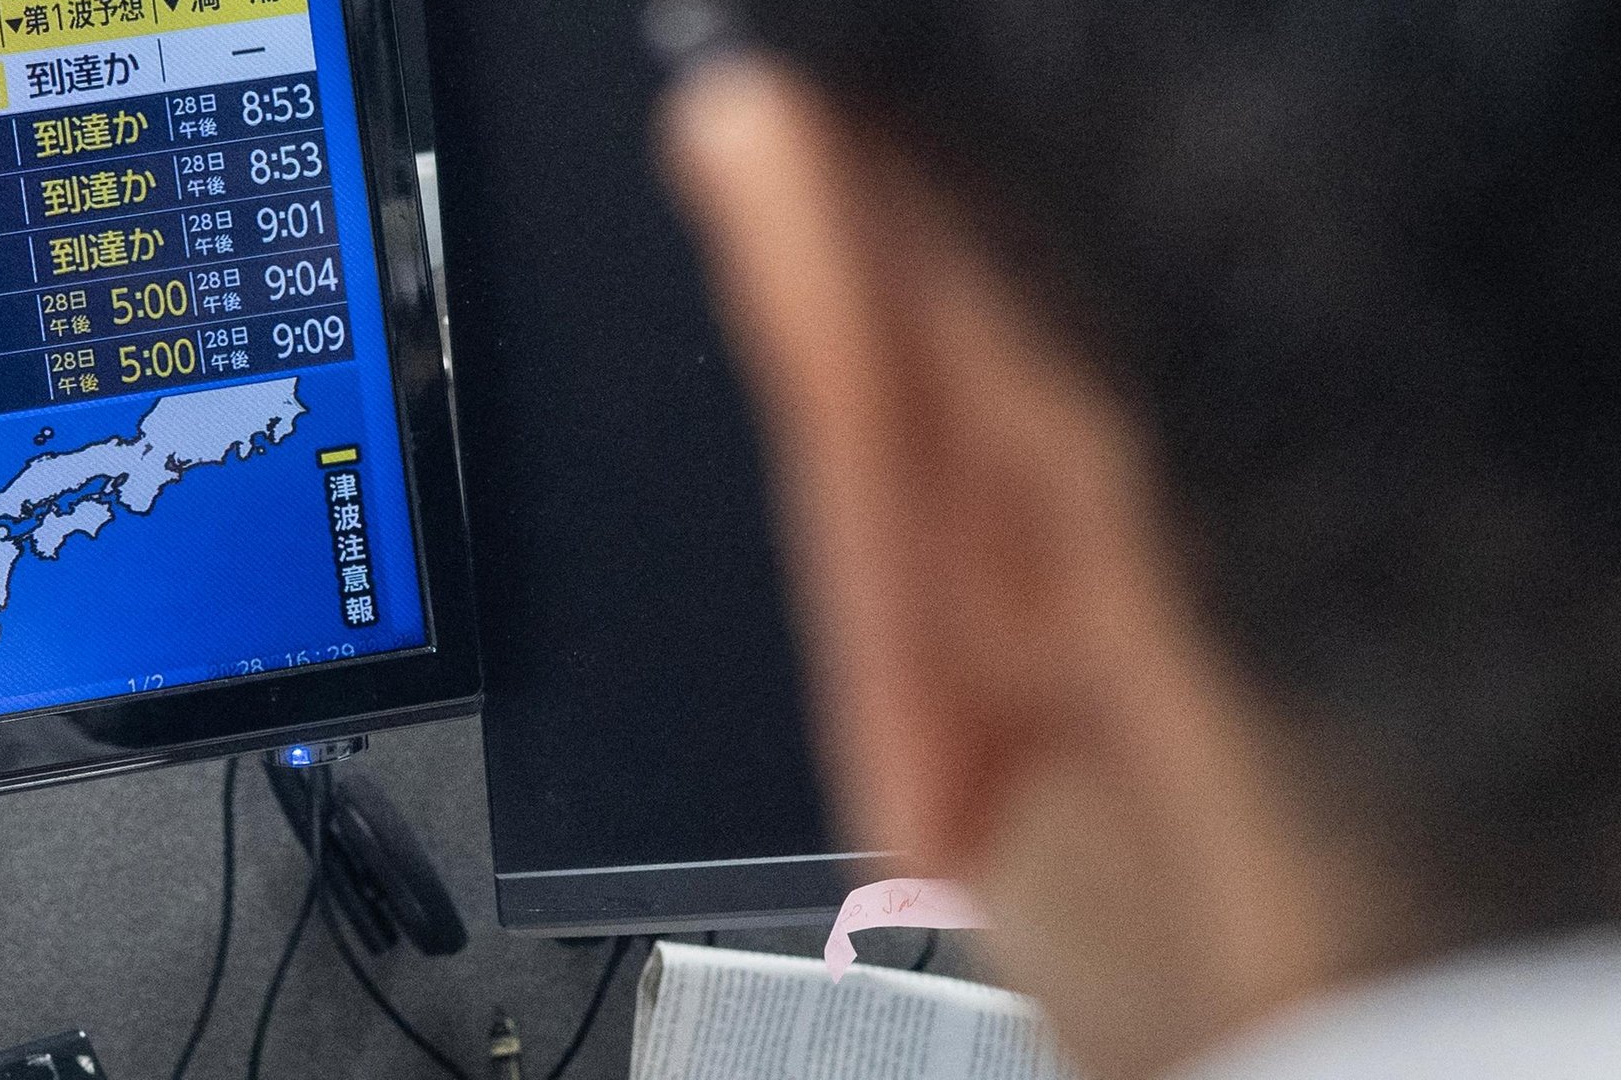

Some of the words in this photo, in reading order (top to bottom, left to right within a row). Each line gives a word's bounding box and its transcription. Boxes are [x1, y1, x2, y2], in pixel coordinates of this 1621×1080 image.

[26, 52, 140, 98] 到達か
[173, 94, 217, 115] 28日
[242, 83, 315, 126] 8:53
[33, 111, 148, 159] 到達か
[179, 119, 218, 138] 午後
[180, 152, 225, 174] 28日
[250, 142, 323, 185] 8:53
[41, 169, 157, 217] 到達か
[187, 176, 226, 198] 午後
[189, 211, 232, 232] 28日
[257, 200, 325, 243] 9:01
[49, 228, 165, 276] 到達か
[194, 235, 234, 256] 午後
[196, 269, 240, 291] 28日
[264, 258, 339, 301] 9:04
[42, 291, 87, 313] 28日
[110, 280, 188, 325] 5:00
[203, 293, 242, 314] 午後
[49, 316, 91, 337] 午後
[272, 315, 345, 359] 9:09
[204, 327, 249, 349] 28日
[51, 350, 95, 372] 28日
[119, 338, 196, 383] 5:00
[210, 351, 250, 372] 午後
[58, 375, 99, 395] 午後
[329, 473, 376, 625] 津波注意報
